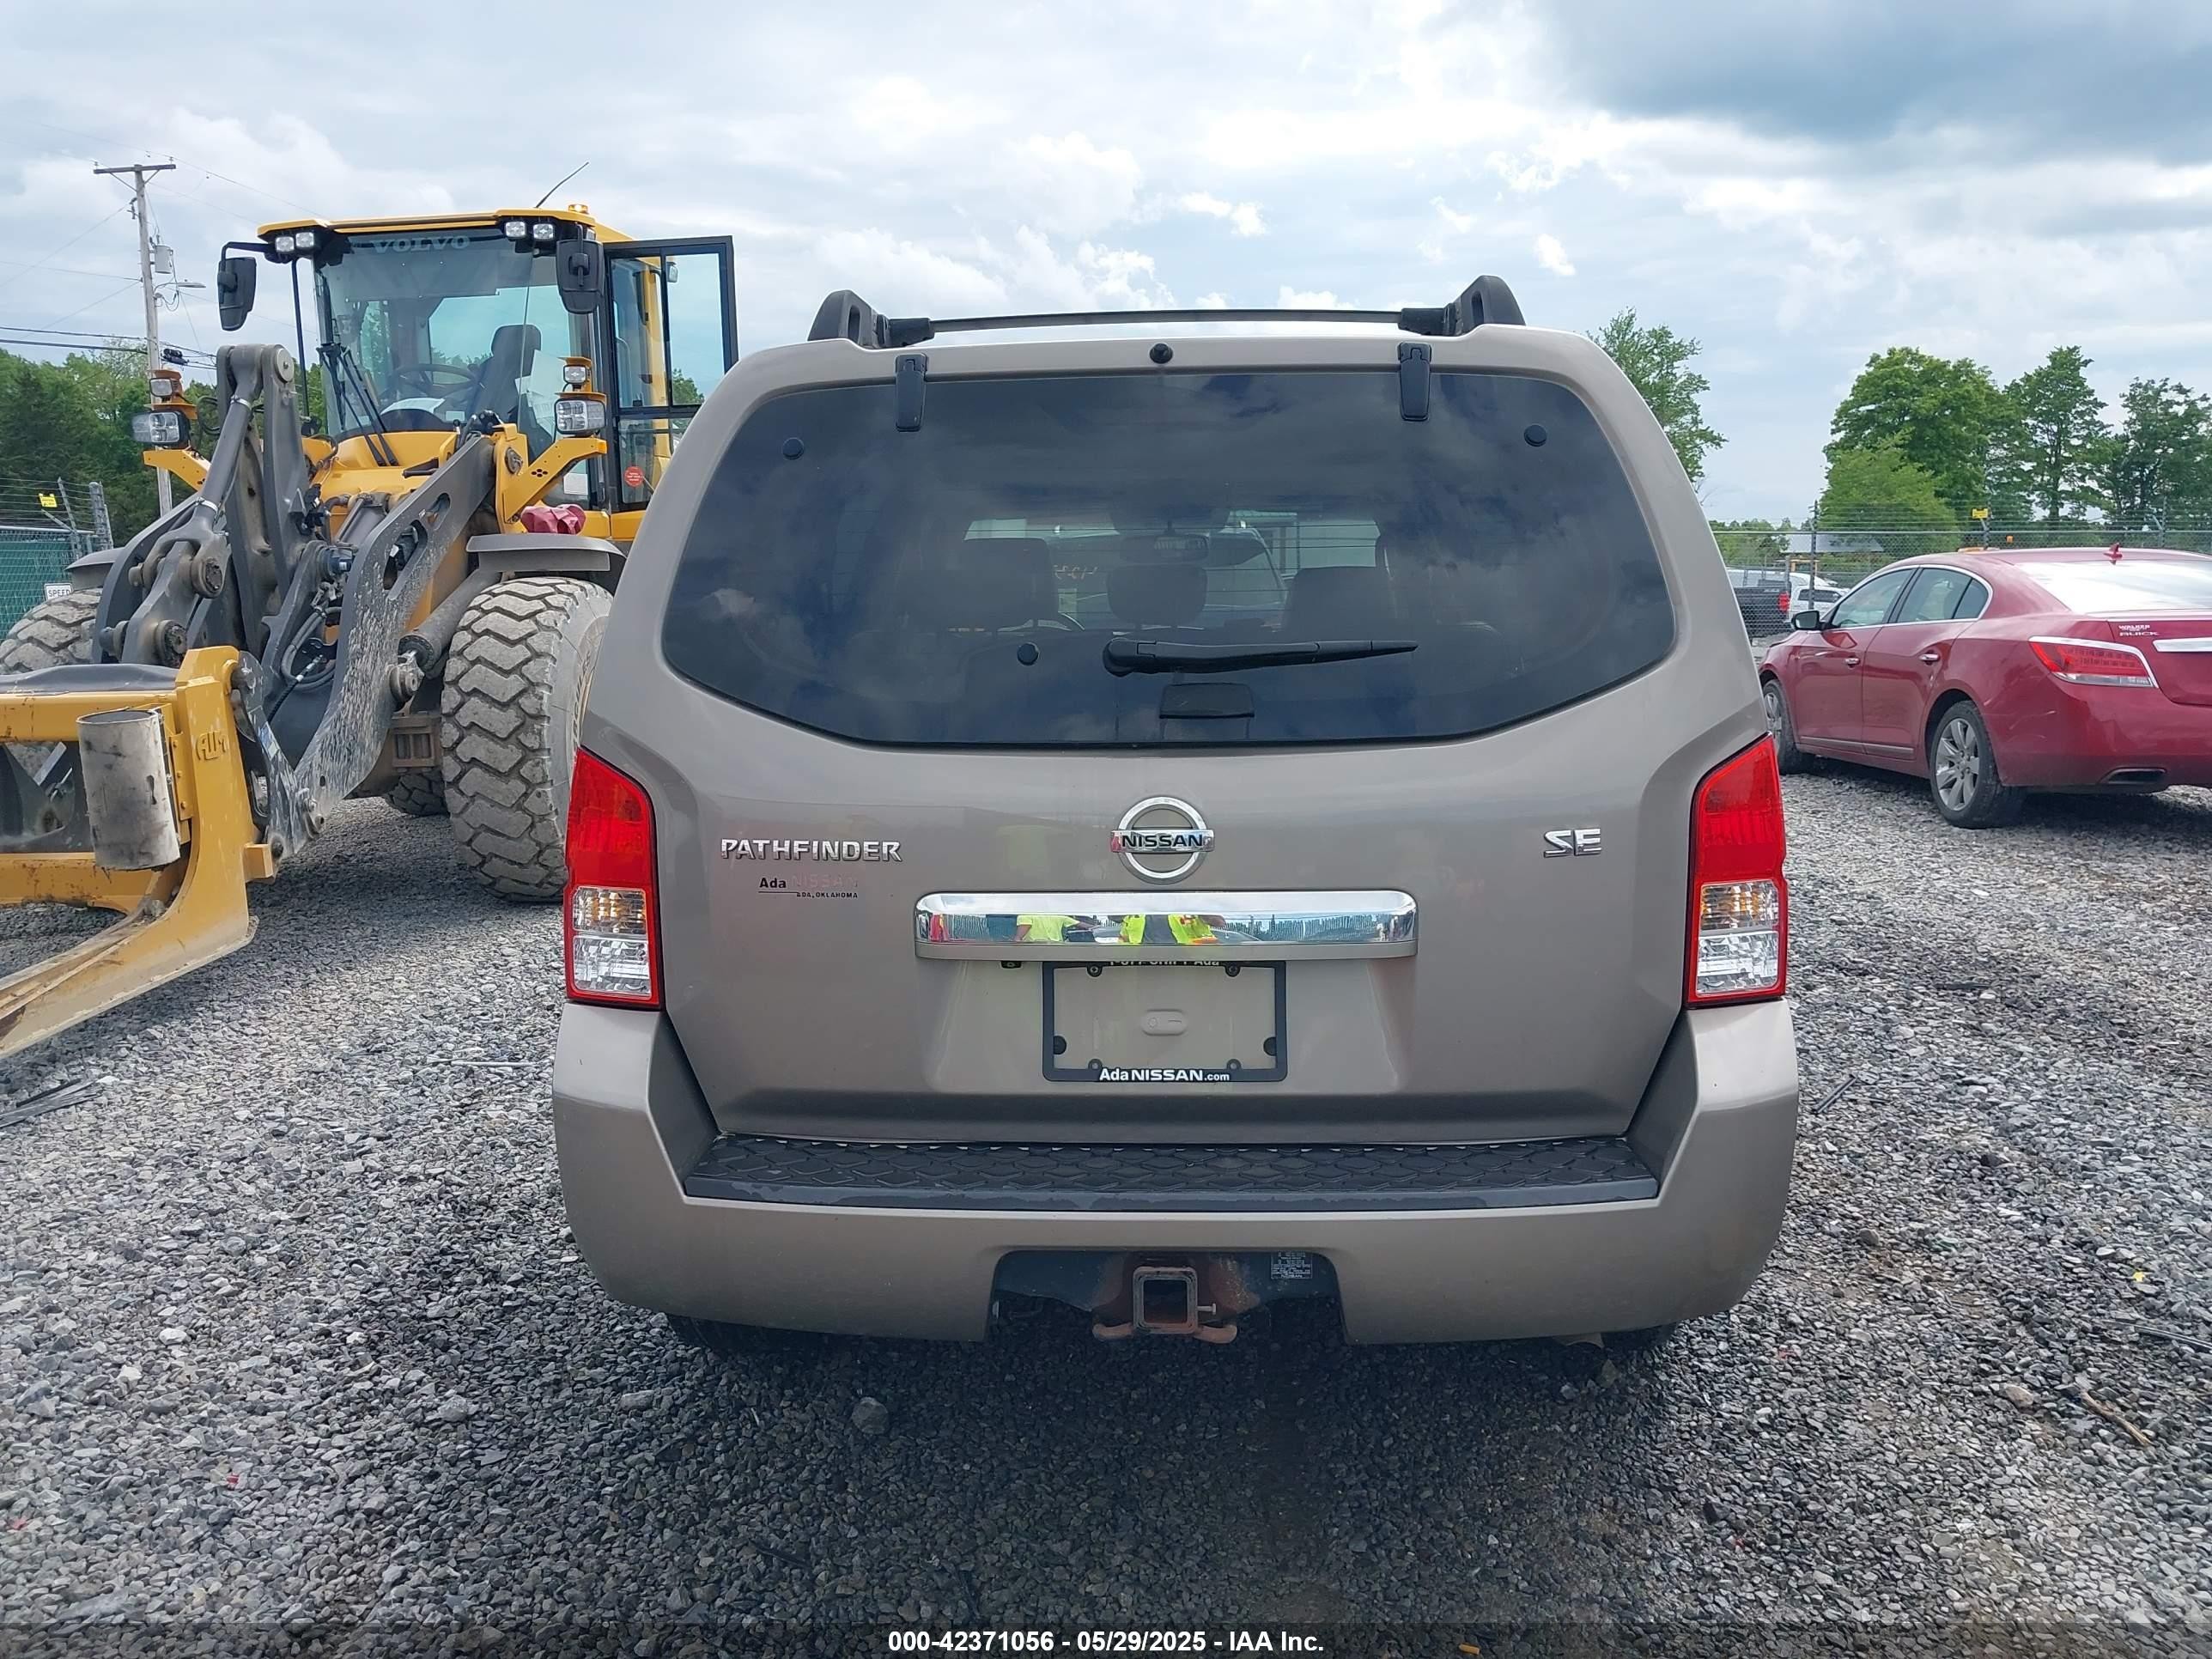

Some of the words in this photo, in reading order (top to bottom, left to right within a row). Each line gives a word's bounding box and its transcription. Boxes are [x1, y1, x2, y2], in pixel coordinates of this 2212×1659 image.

[370, 235, 470, 253] VOLVO
[721, 838, 902, 861] PATHFINDER
[1121, 835, 1203, 848] NISSAN
[1544, 828, 1602, 858] SE
[759, 878, 787, 889] Ada
